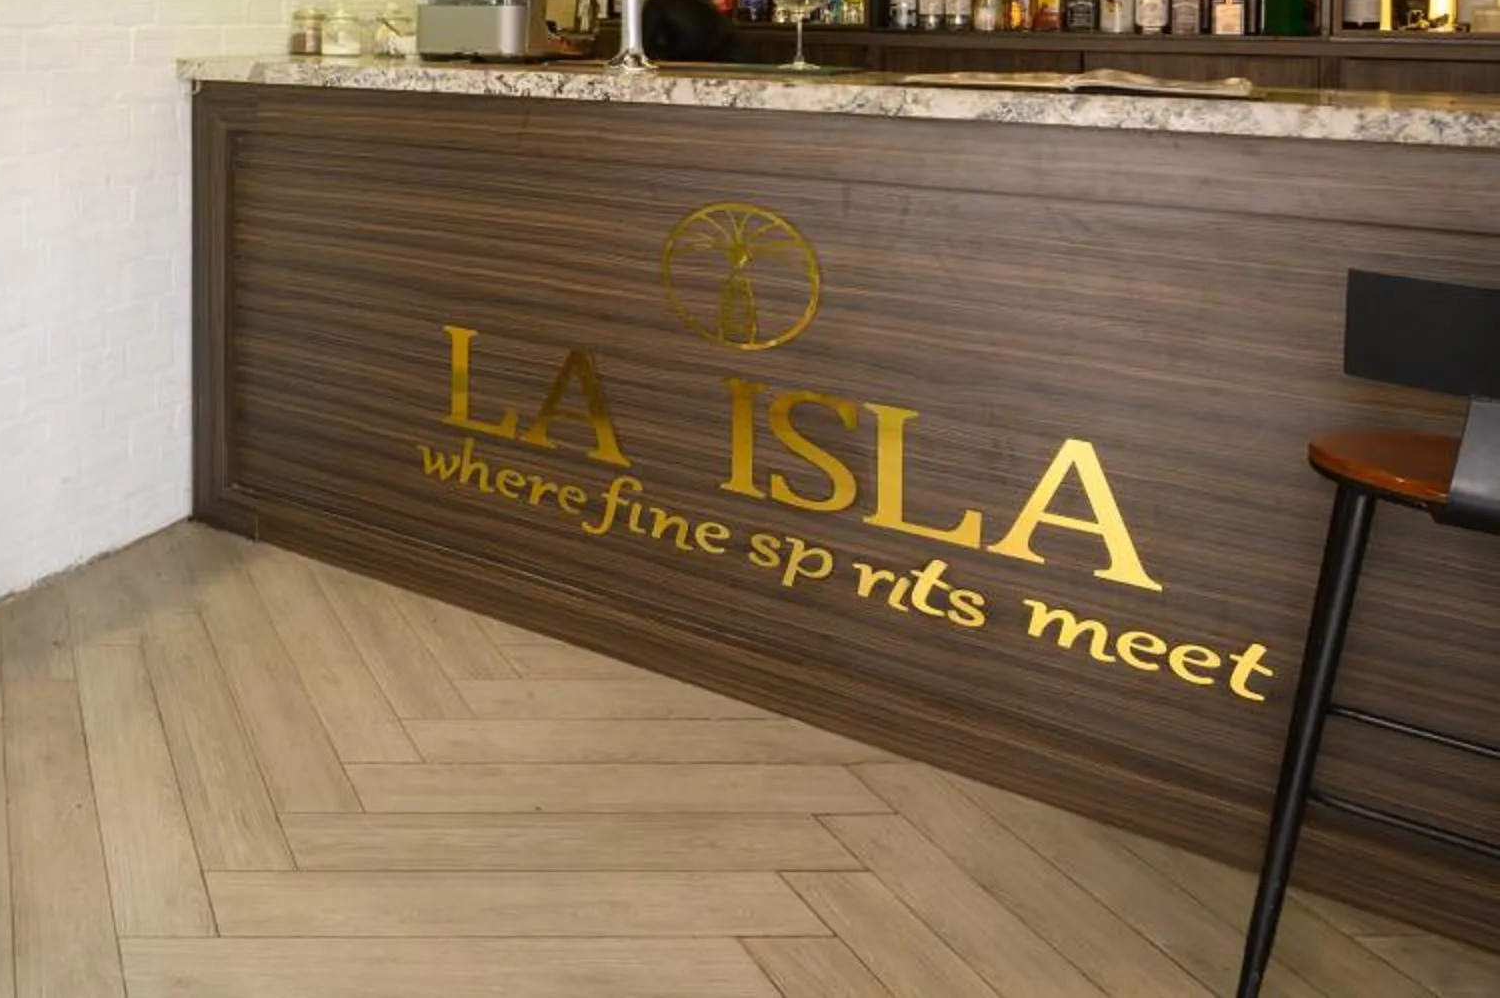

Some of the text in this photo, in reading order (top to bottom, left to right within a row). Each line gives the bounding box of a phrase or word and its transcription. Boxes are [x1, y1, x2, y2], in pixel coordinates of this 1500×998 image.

[418, 436, 588, 515] where
[581, 475, 731, 553] fine
[1023, 598, 1274, 702] meet
[442, 325, 1163, 592] LA ISLA
